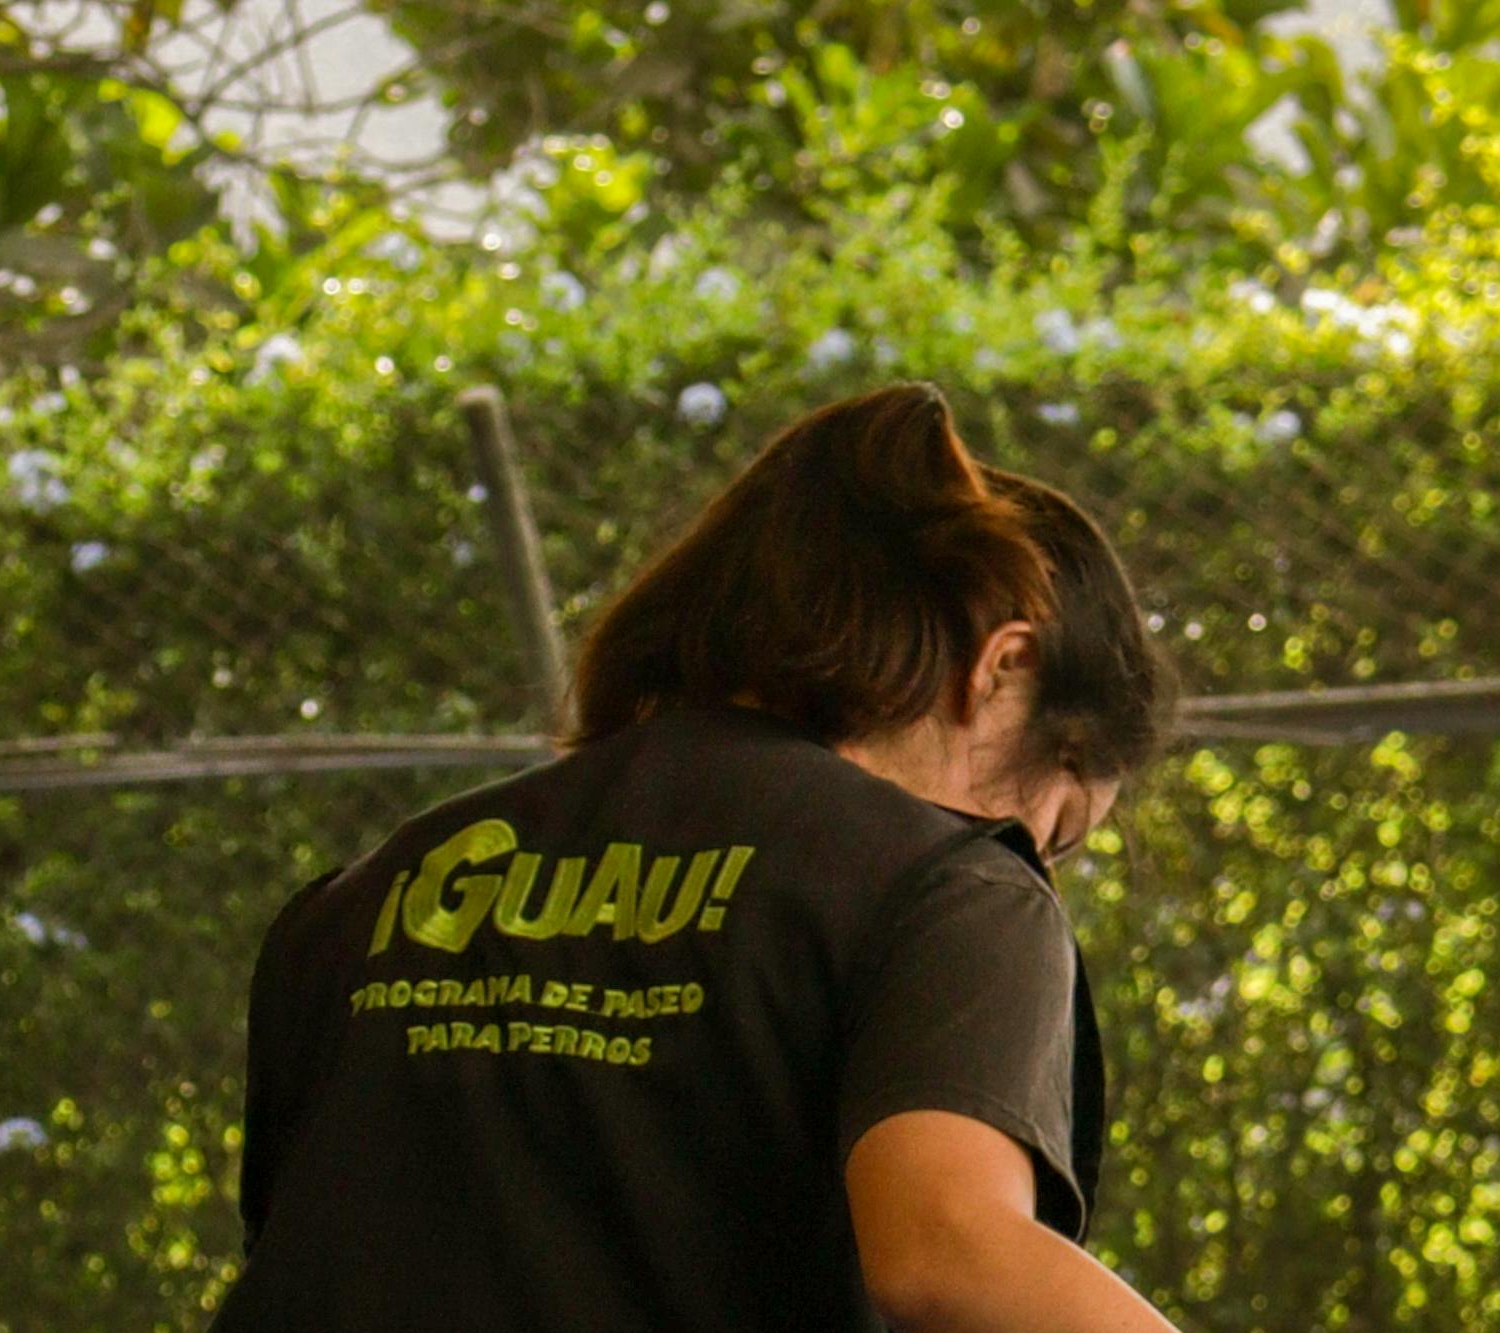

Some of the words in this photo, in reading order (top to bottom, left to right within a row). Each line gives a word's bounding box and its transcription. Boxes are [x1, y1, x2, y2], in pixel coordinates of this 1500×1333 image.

[350, 974, 532, 1017] PROGRAMA
[539, 979, 594, 1012] DE
[601, 981, 705, 1019] PASEO
[407, 1021, 501, 1055] PARA
[507, 1021, 653, 1066] PERROS
